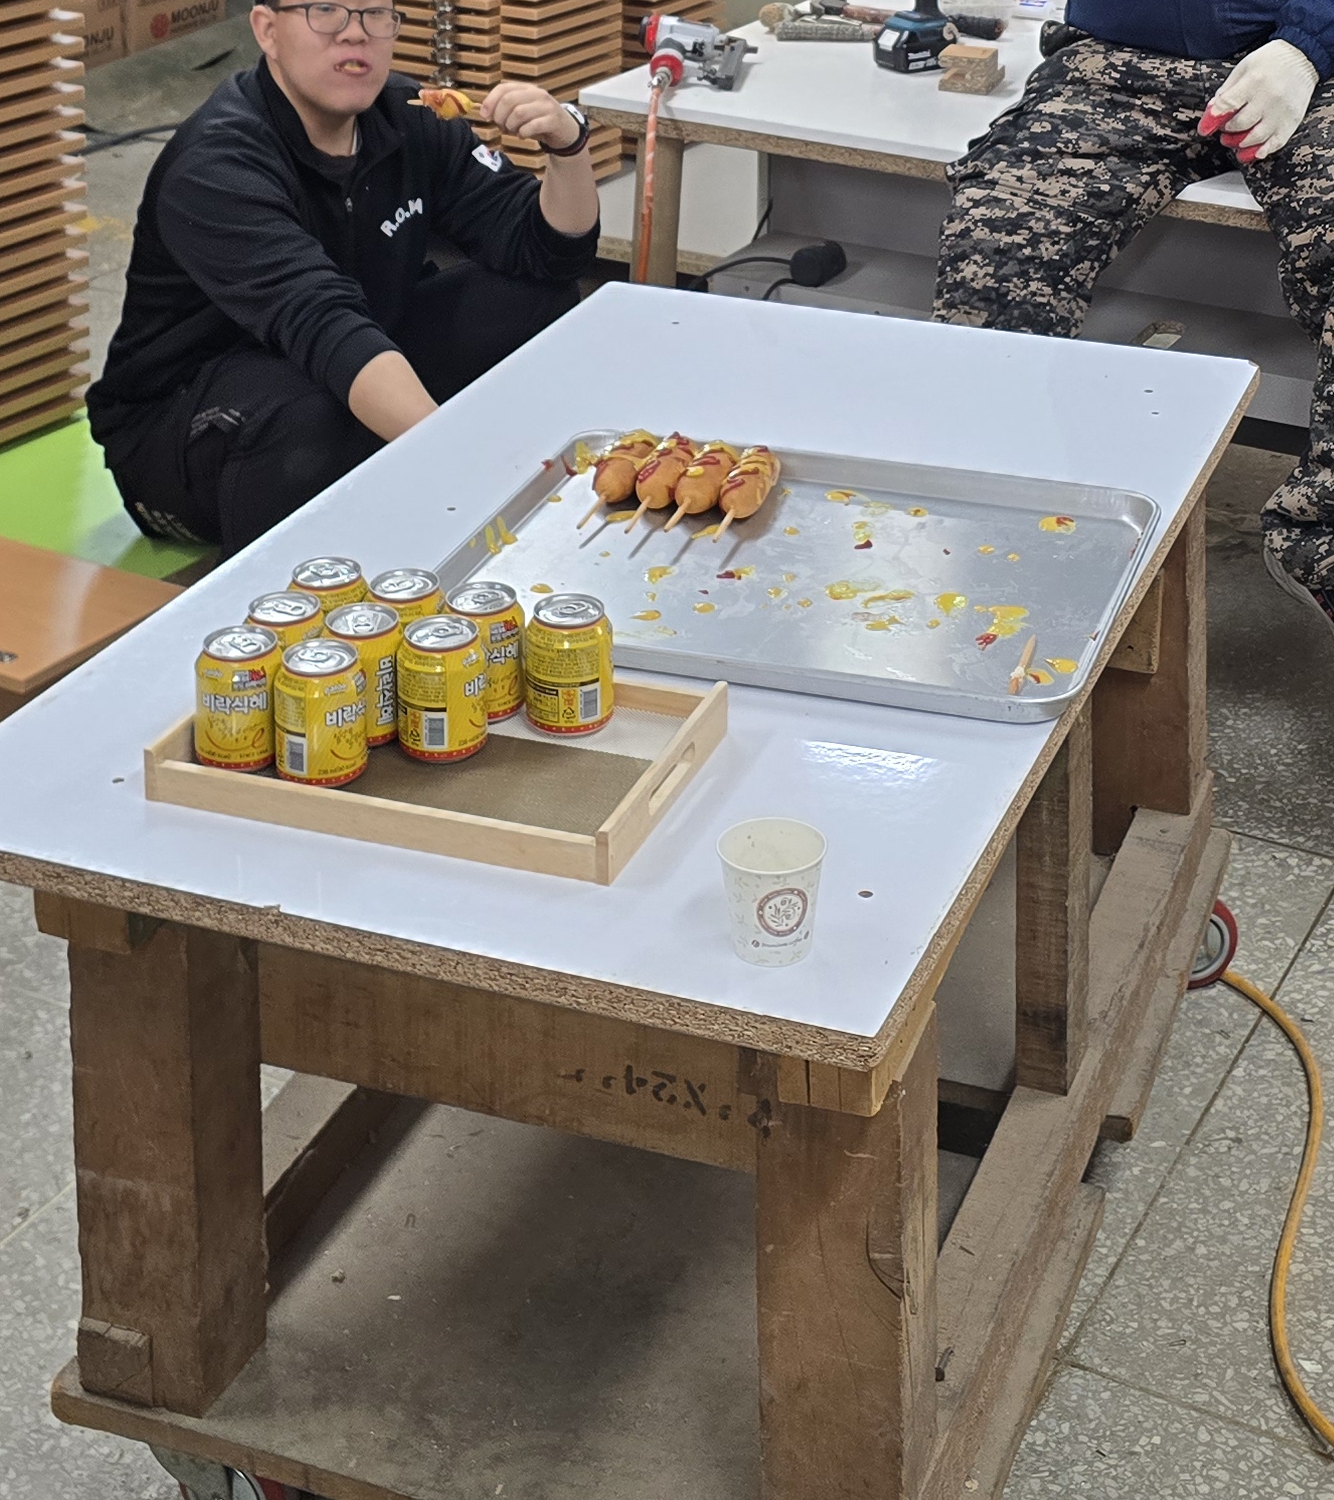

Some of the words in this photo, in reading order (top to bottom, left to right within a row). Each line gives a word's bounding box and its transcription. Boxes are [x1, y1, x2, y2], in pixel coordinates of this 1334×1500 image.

[82, 26, 115, 48] ONJU
[202, 690, 269, 716] 비락식혜
[373, 654, 396, 727] 비락식혜
